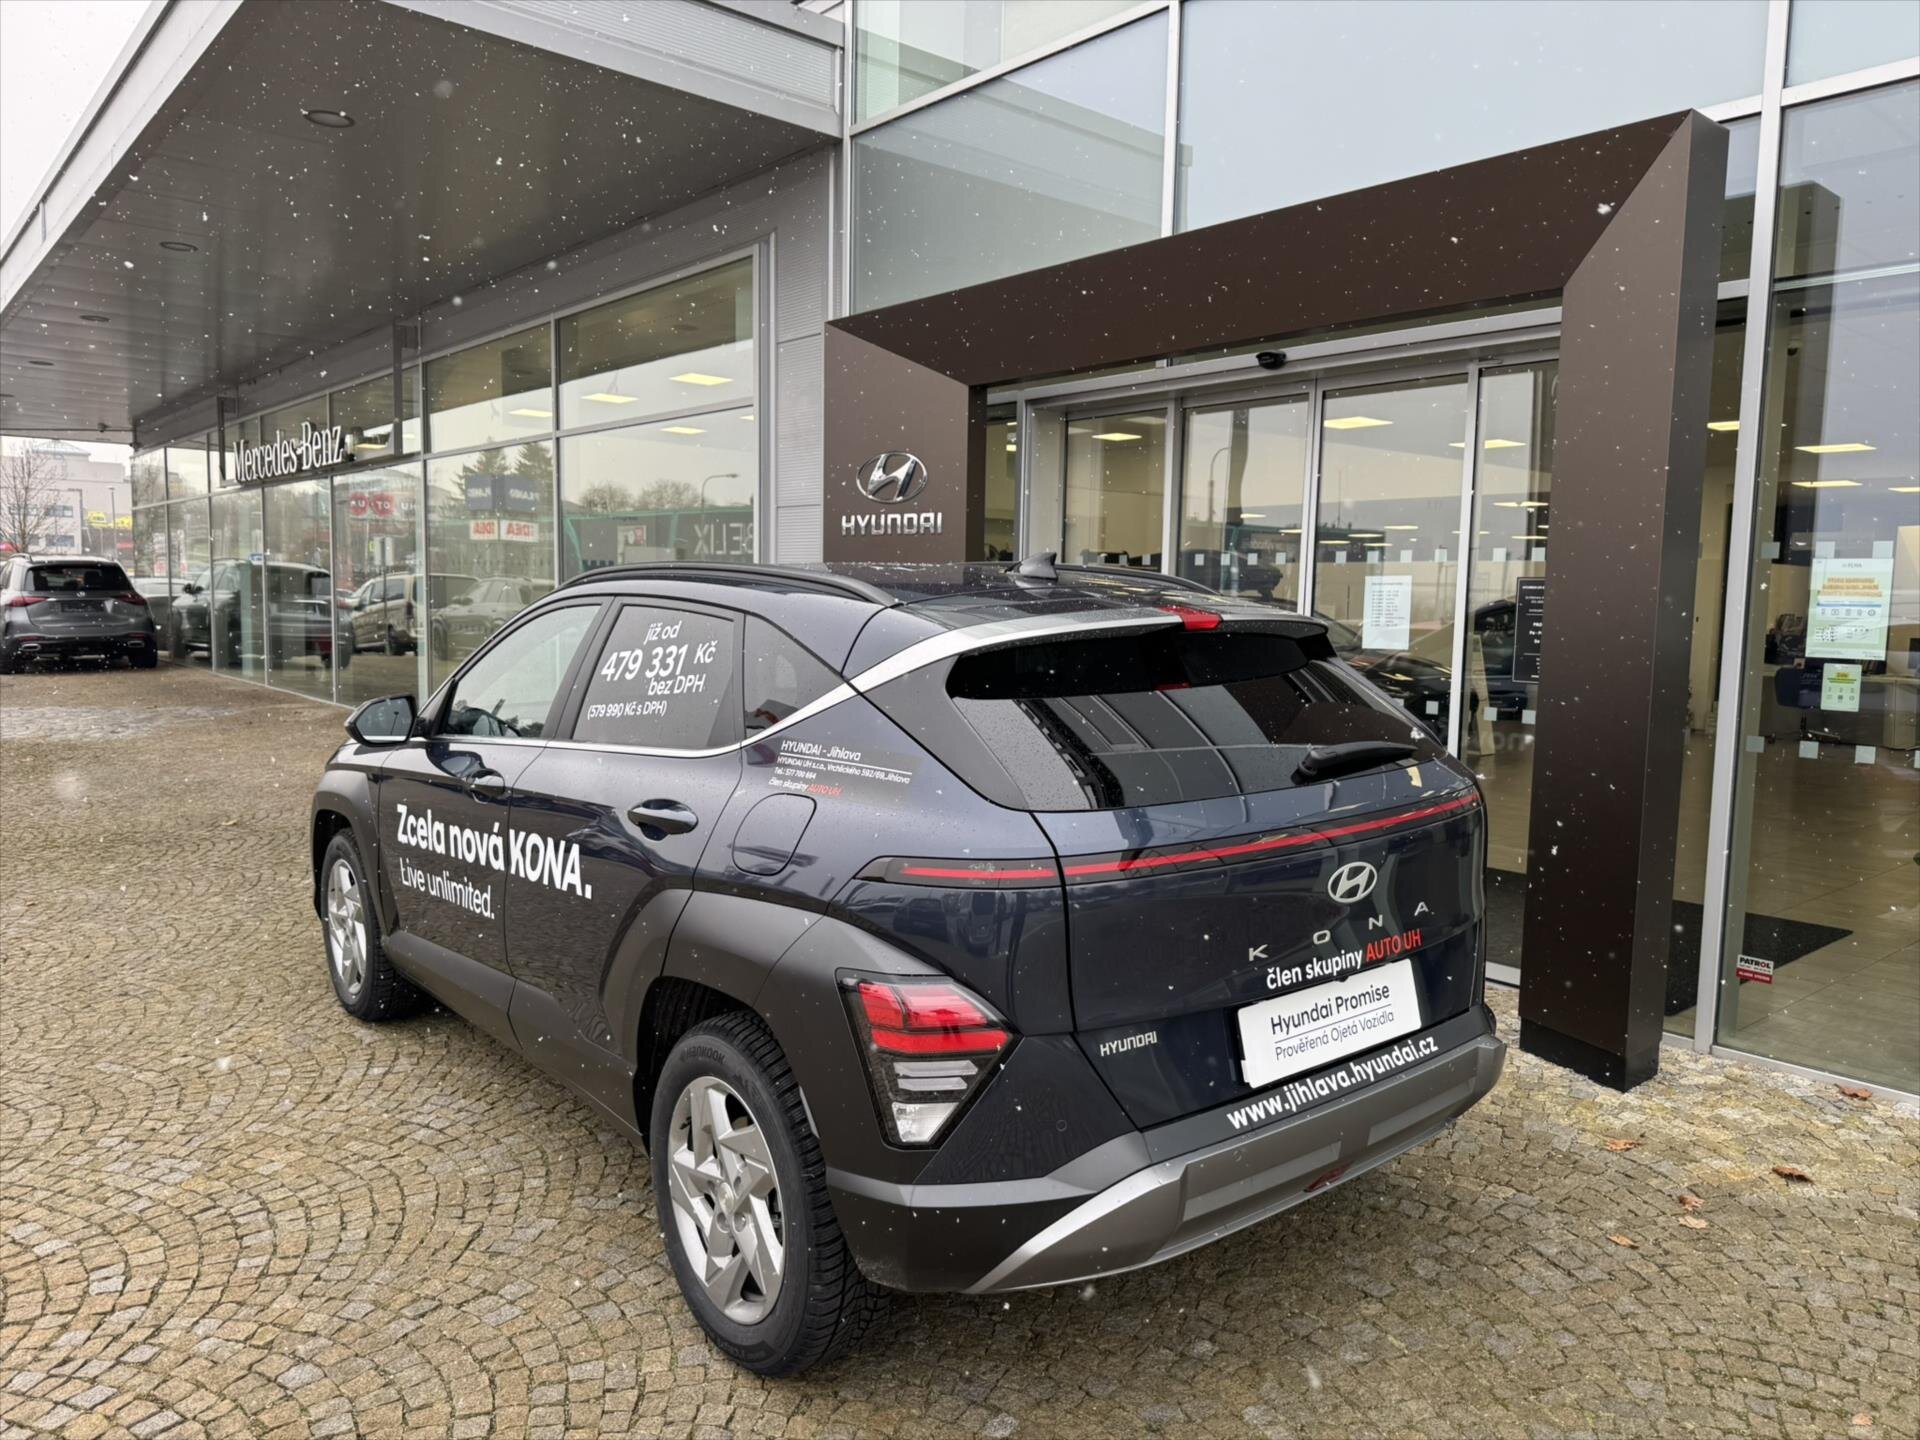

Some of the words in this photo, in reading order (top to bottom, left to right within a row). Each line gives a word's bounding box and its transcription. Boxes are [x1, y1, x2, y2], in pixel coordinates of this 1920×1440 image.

[233, 421, 343, 483] Mercedes-Benz
[841, 512, 942, 536] HYUNDAI
[643, 621, 663, 645] již
[661, 620, 682, 639] od
[601, 648, 644, 682] 479
[645, 644, 689, 678] 331
[693, 640, 718, 664] Kč
[647, 677, 674, 696] bez
[673, 674, 706, 694] DPH
[587, 703, 606, 720] (579
[642, 700, 668, 717] DPH)
[780, 740, 823, 756] HYUNDAI
[827, 746, 862, 761] Jihlava
[396, 803, 446, 855] Zcela
[449, 822, 505, 871] nová
[509, 828, 593, 900] KONA.
[399, 857, 426, 892] Live
[427, 870, 496, 920] unlimited.
[1266, 966, 1302, 990] člen
[1305, 949, 1363, 981] skupiny
[1365, 934, 1402, 963] AUTO
[1402, 928, 1422, 949] UH
[1740, 957, 1772, 969] PATROL
[1270, 999, 1334, 1036] Hyundai
[1335, 984, 1391, 1015] Promise
[1099, 1030, 1158, 1057] HYUNDAI
[1275, 1029, 1330, 1061] Prověřená
[1330, 1023, 1359, 1042] Ojetá
[1358, 1010, 1396, 1032] Vozidla
[1226, 1036, 1440, 1130] www.jihlava.hyundai.cz
